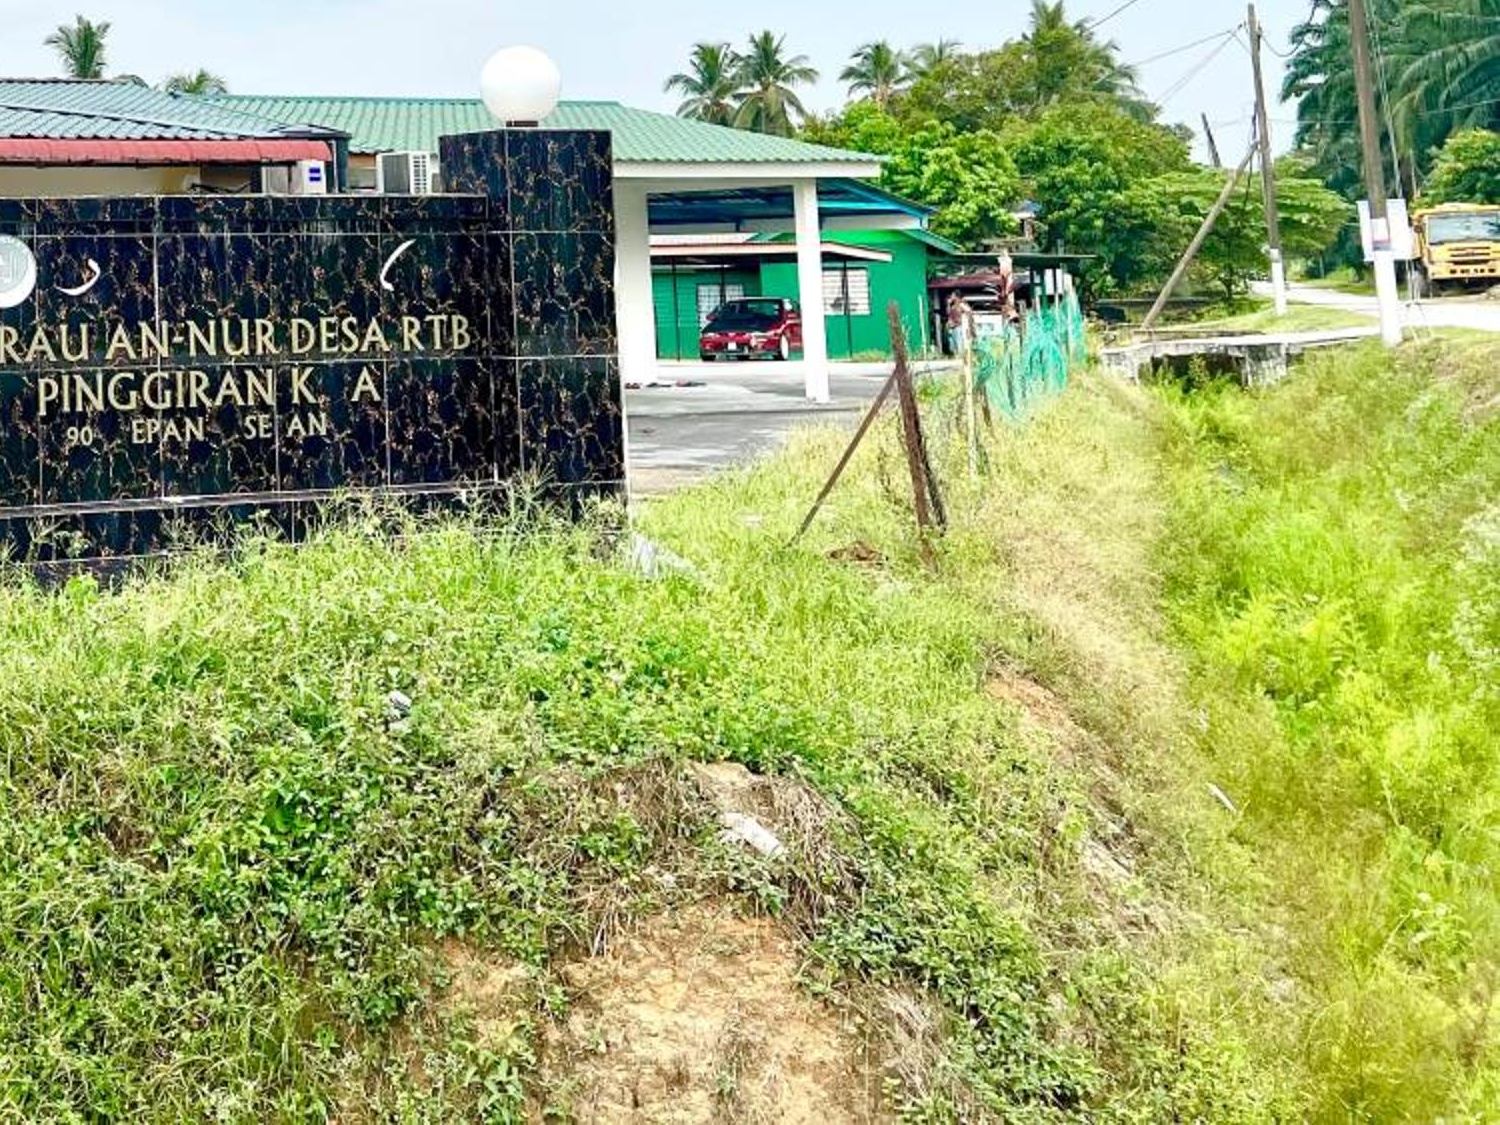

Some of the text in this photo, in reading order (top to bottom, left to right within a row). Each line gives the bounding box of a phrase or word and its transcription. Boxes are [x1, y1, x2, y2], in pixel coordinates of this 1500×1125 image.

[105, 318, 281, 360] AN-NUR
[290, 316, 391, 354] DESA
[401, 314, 471, 352] RTB
[37, 369, 276, 416] PINGGIRAN
